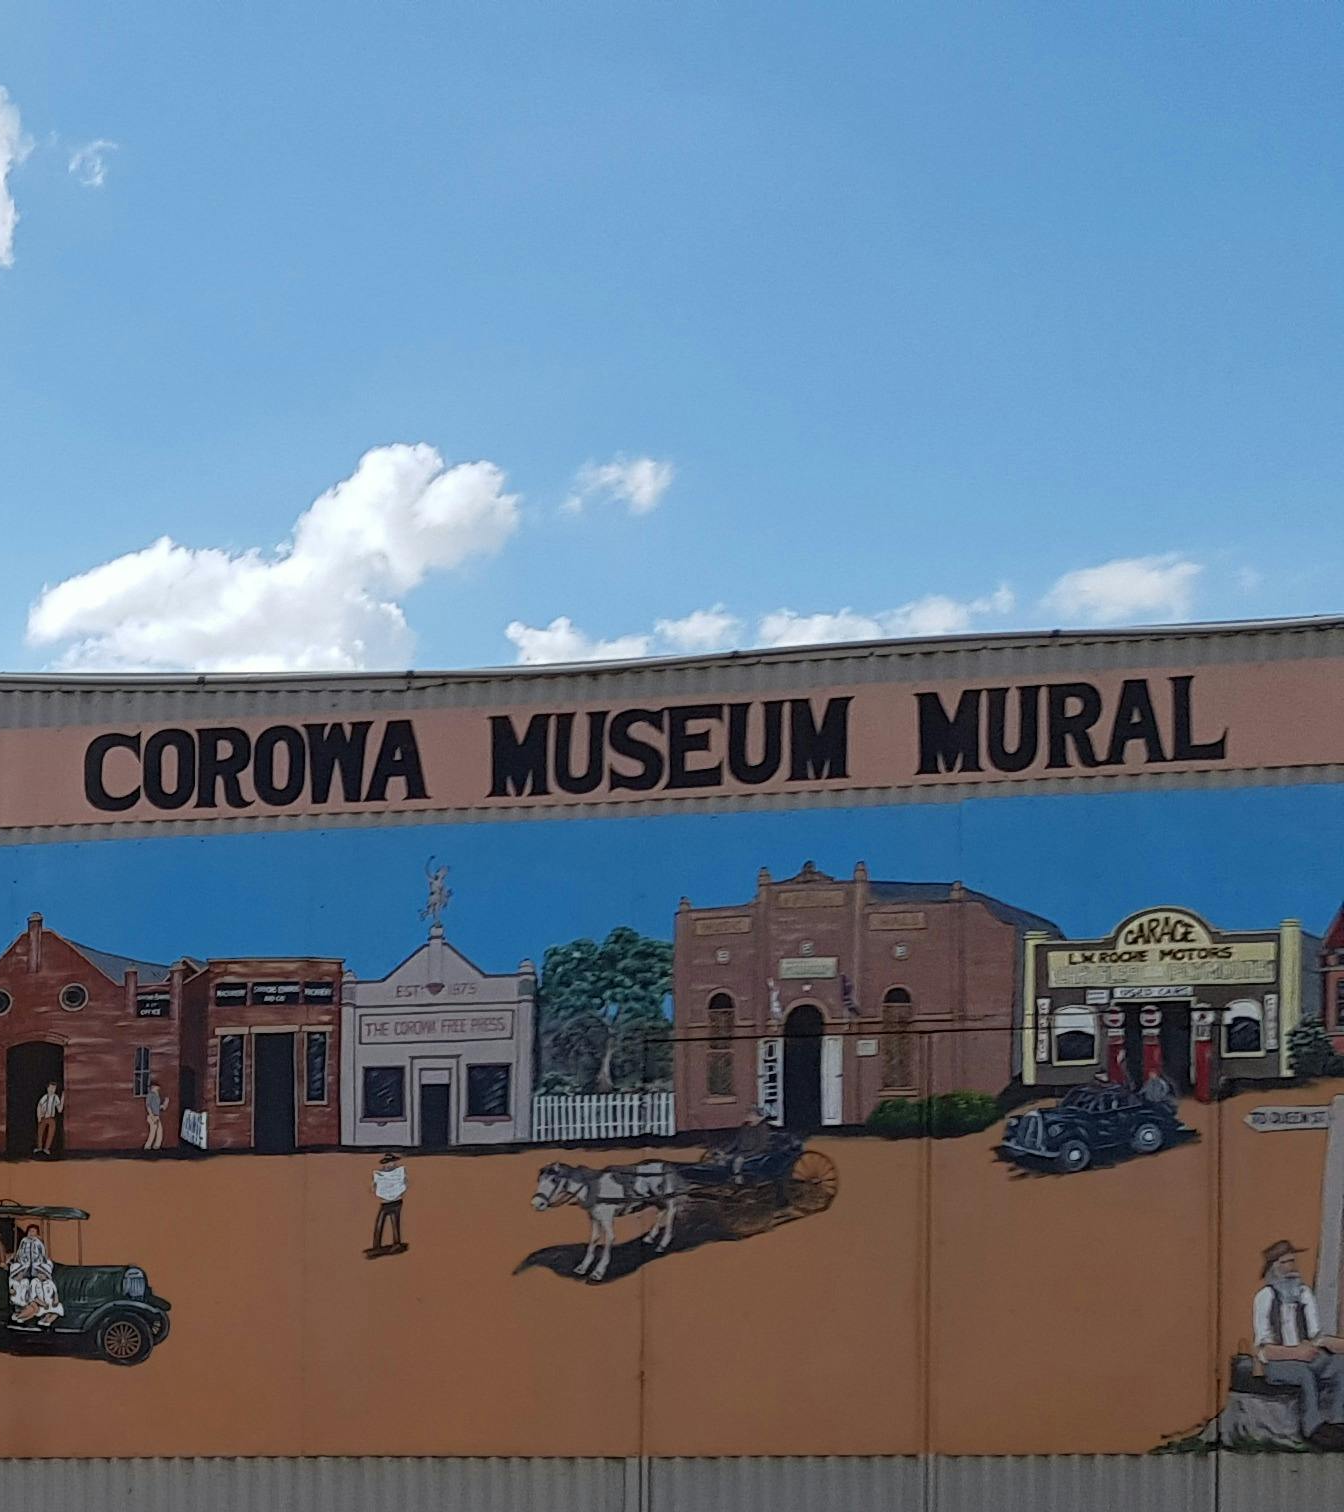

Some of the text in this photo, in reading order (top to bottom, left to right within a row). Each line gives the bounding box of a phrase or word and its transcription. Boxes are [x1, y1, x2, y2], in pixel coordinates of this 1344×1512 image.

[83, 674, 1227, 812] COROWA MUSEUM MURAL
[1124, 917, 1197, 945] GARAGE
[1159, 946, 1233, 962] MOTORS
[365, 1017, 506, 1036] THE COROWA FREE PRESS
